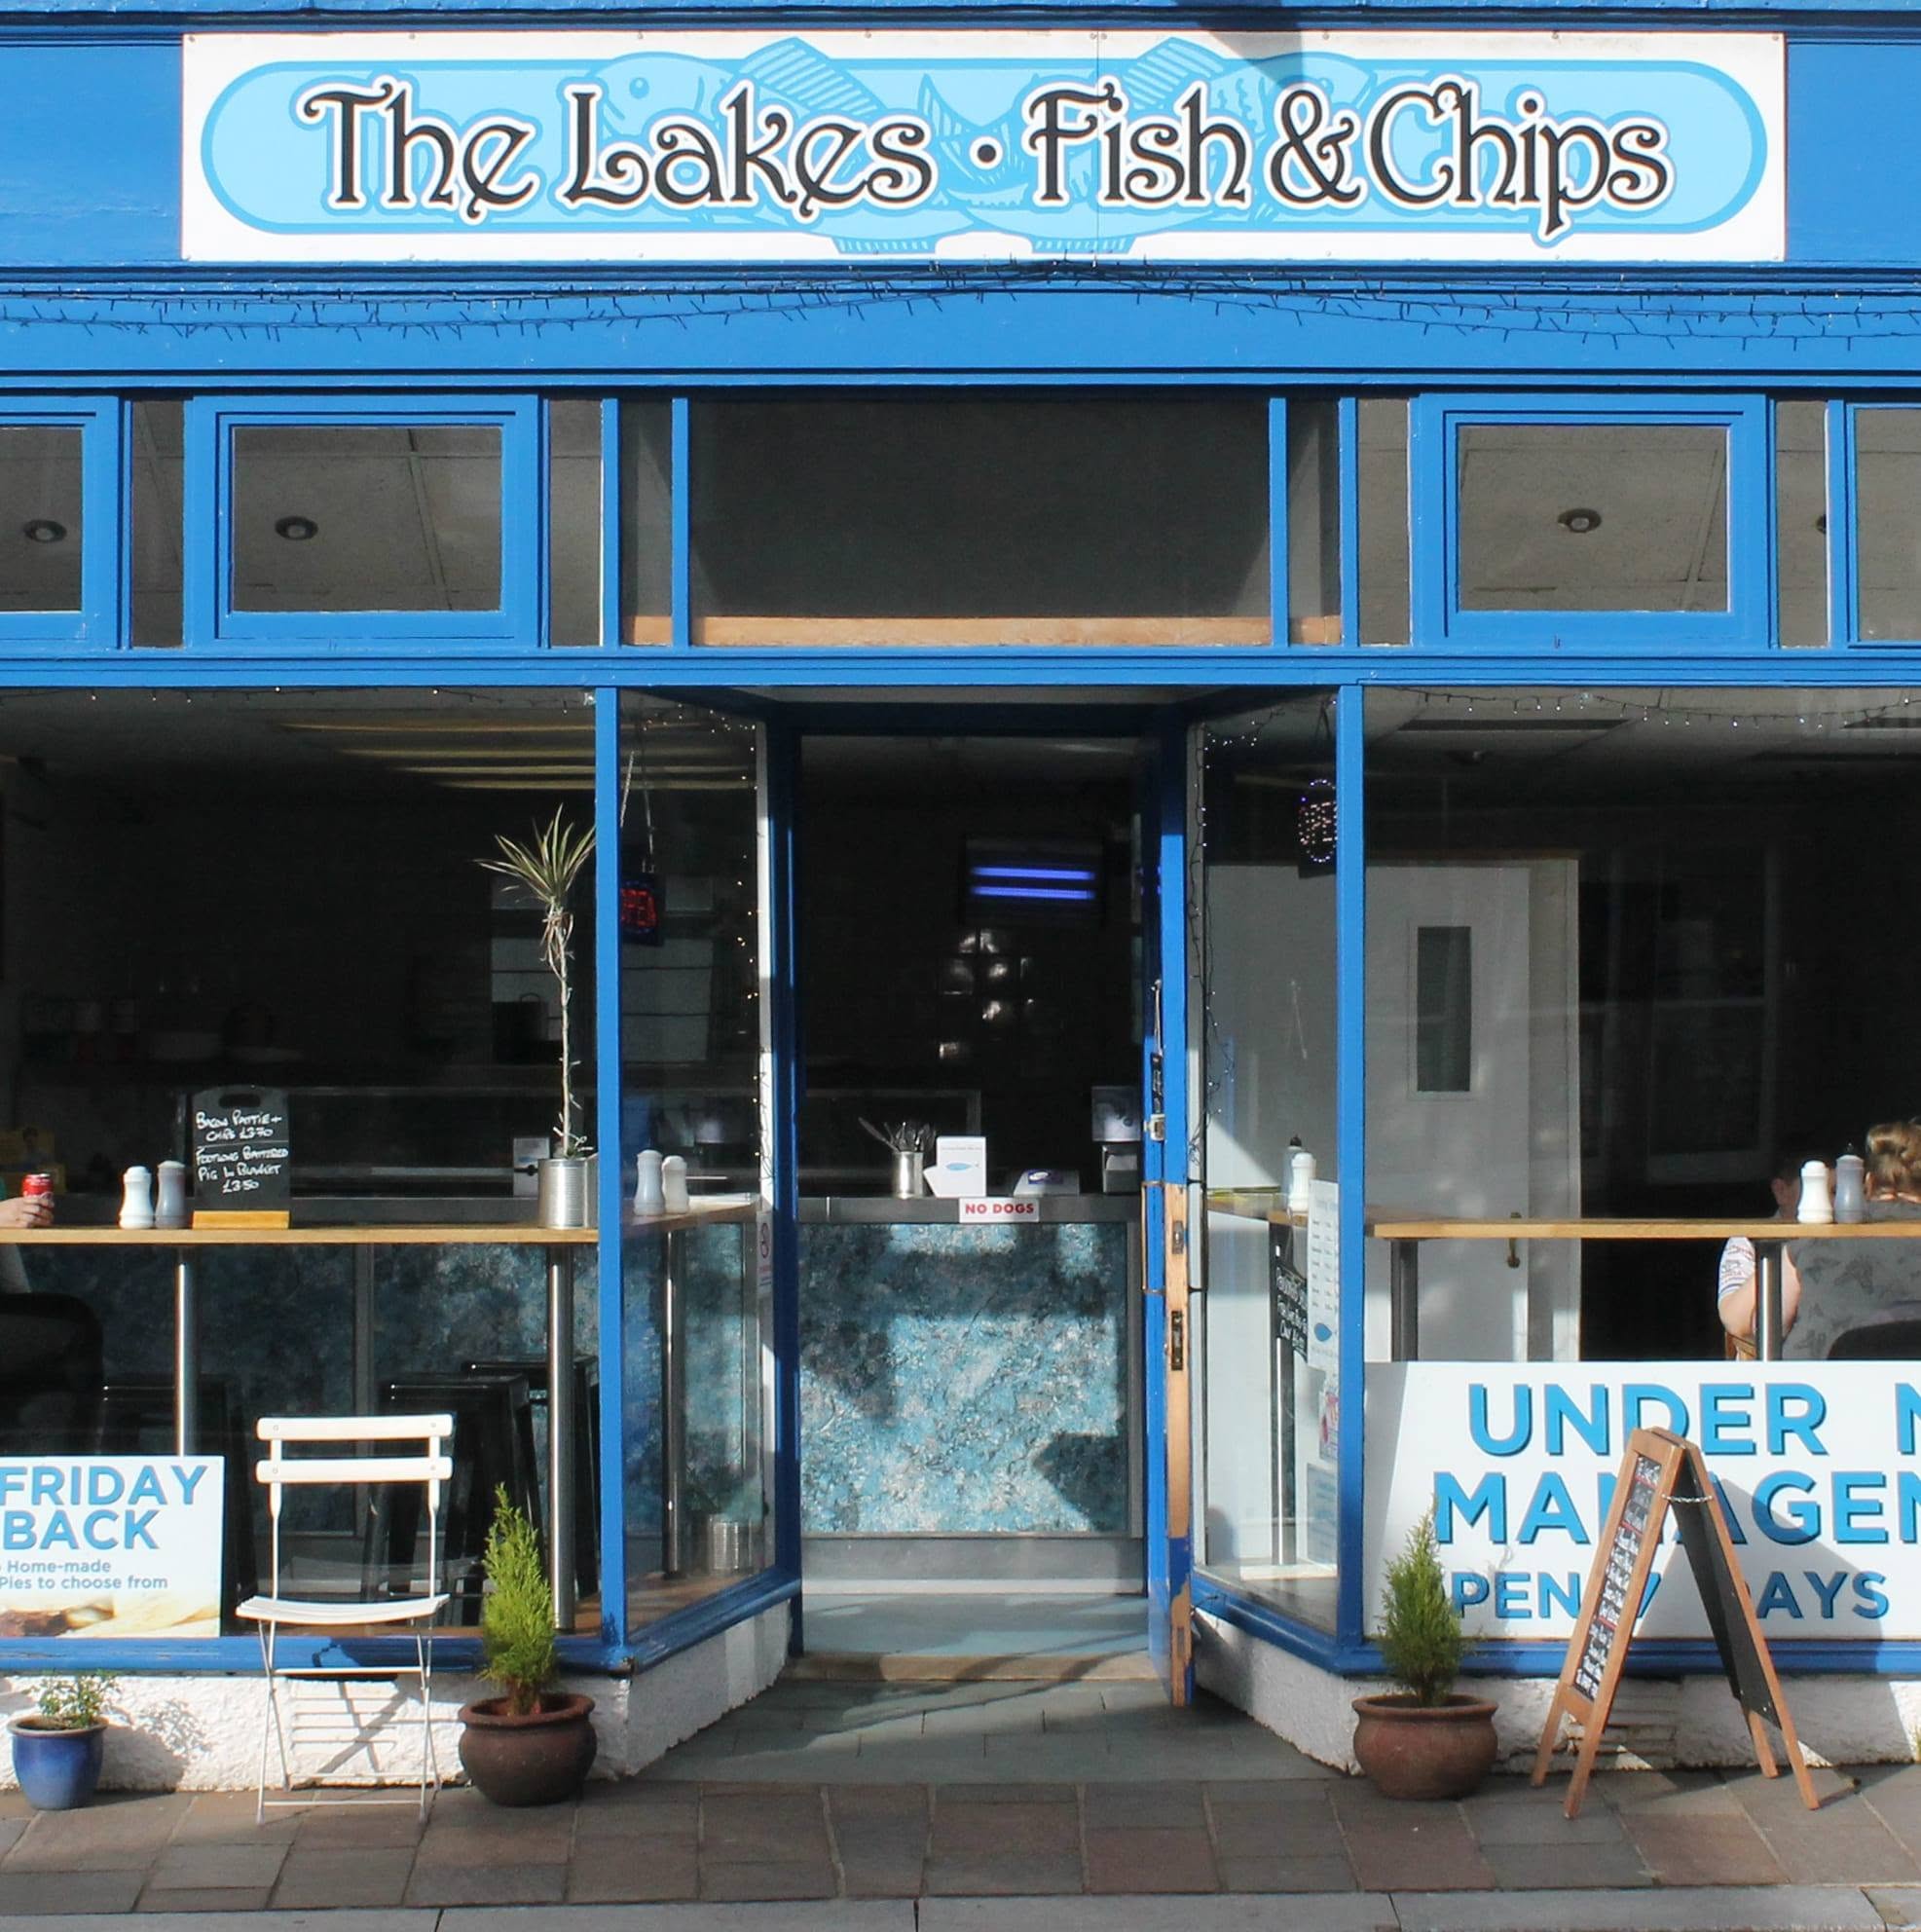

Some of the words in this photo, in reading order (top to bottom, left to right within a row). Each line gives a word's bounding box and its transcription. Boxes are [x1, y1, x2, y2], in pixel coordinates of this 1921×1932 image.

[304, 82, 536, 221] The
[563, 80, 939, 218] Lakes
[1028, 82, 1248, 204] Fish
[1271, 82, 1360, 204] &
[1369, 81, 1670, 237] Chips
[965, 1203, 987, 1214] NO
[992, 1203, 1034, 1214] DOGS
[1468, 1383, 1829, 1457] UNDER
[0, 1465, 208, 1505] FRIDAY
[1433, 1469, 1921, 1545] MAGE
[3, 1508, 161, 1550] BACK
[7, 1560, 112, 1573] Home-made
[38, 1577, 55, 1589] to
[60, 1576, 122, 1589] choose
[128, 1576, 168, 1589] from
[1451, 1571, 1583, 1619] PEN
[1746, 1570, 1890, 1619] AYS
